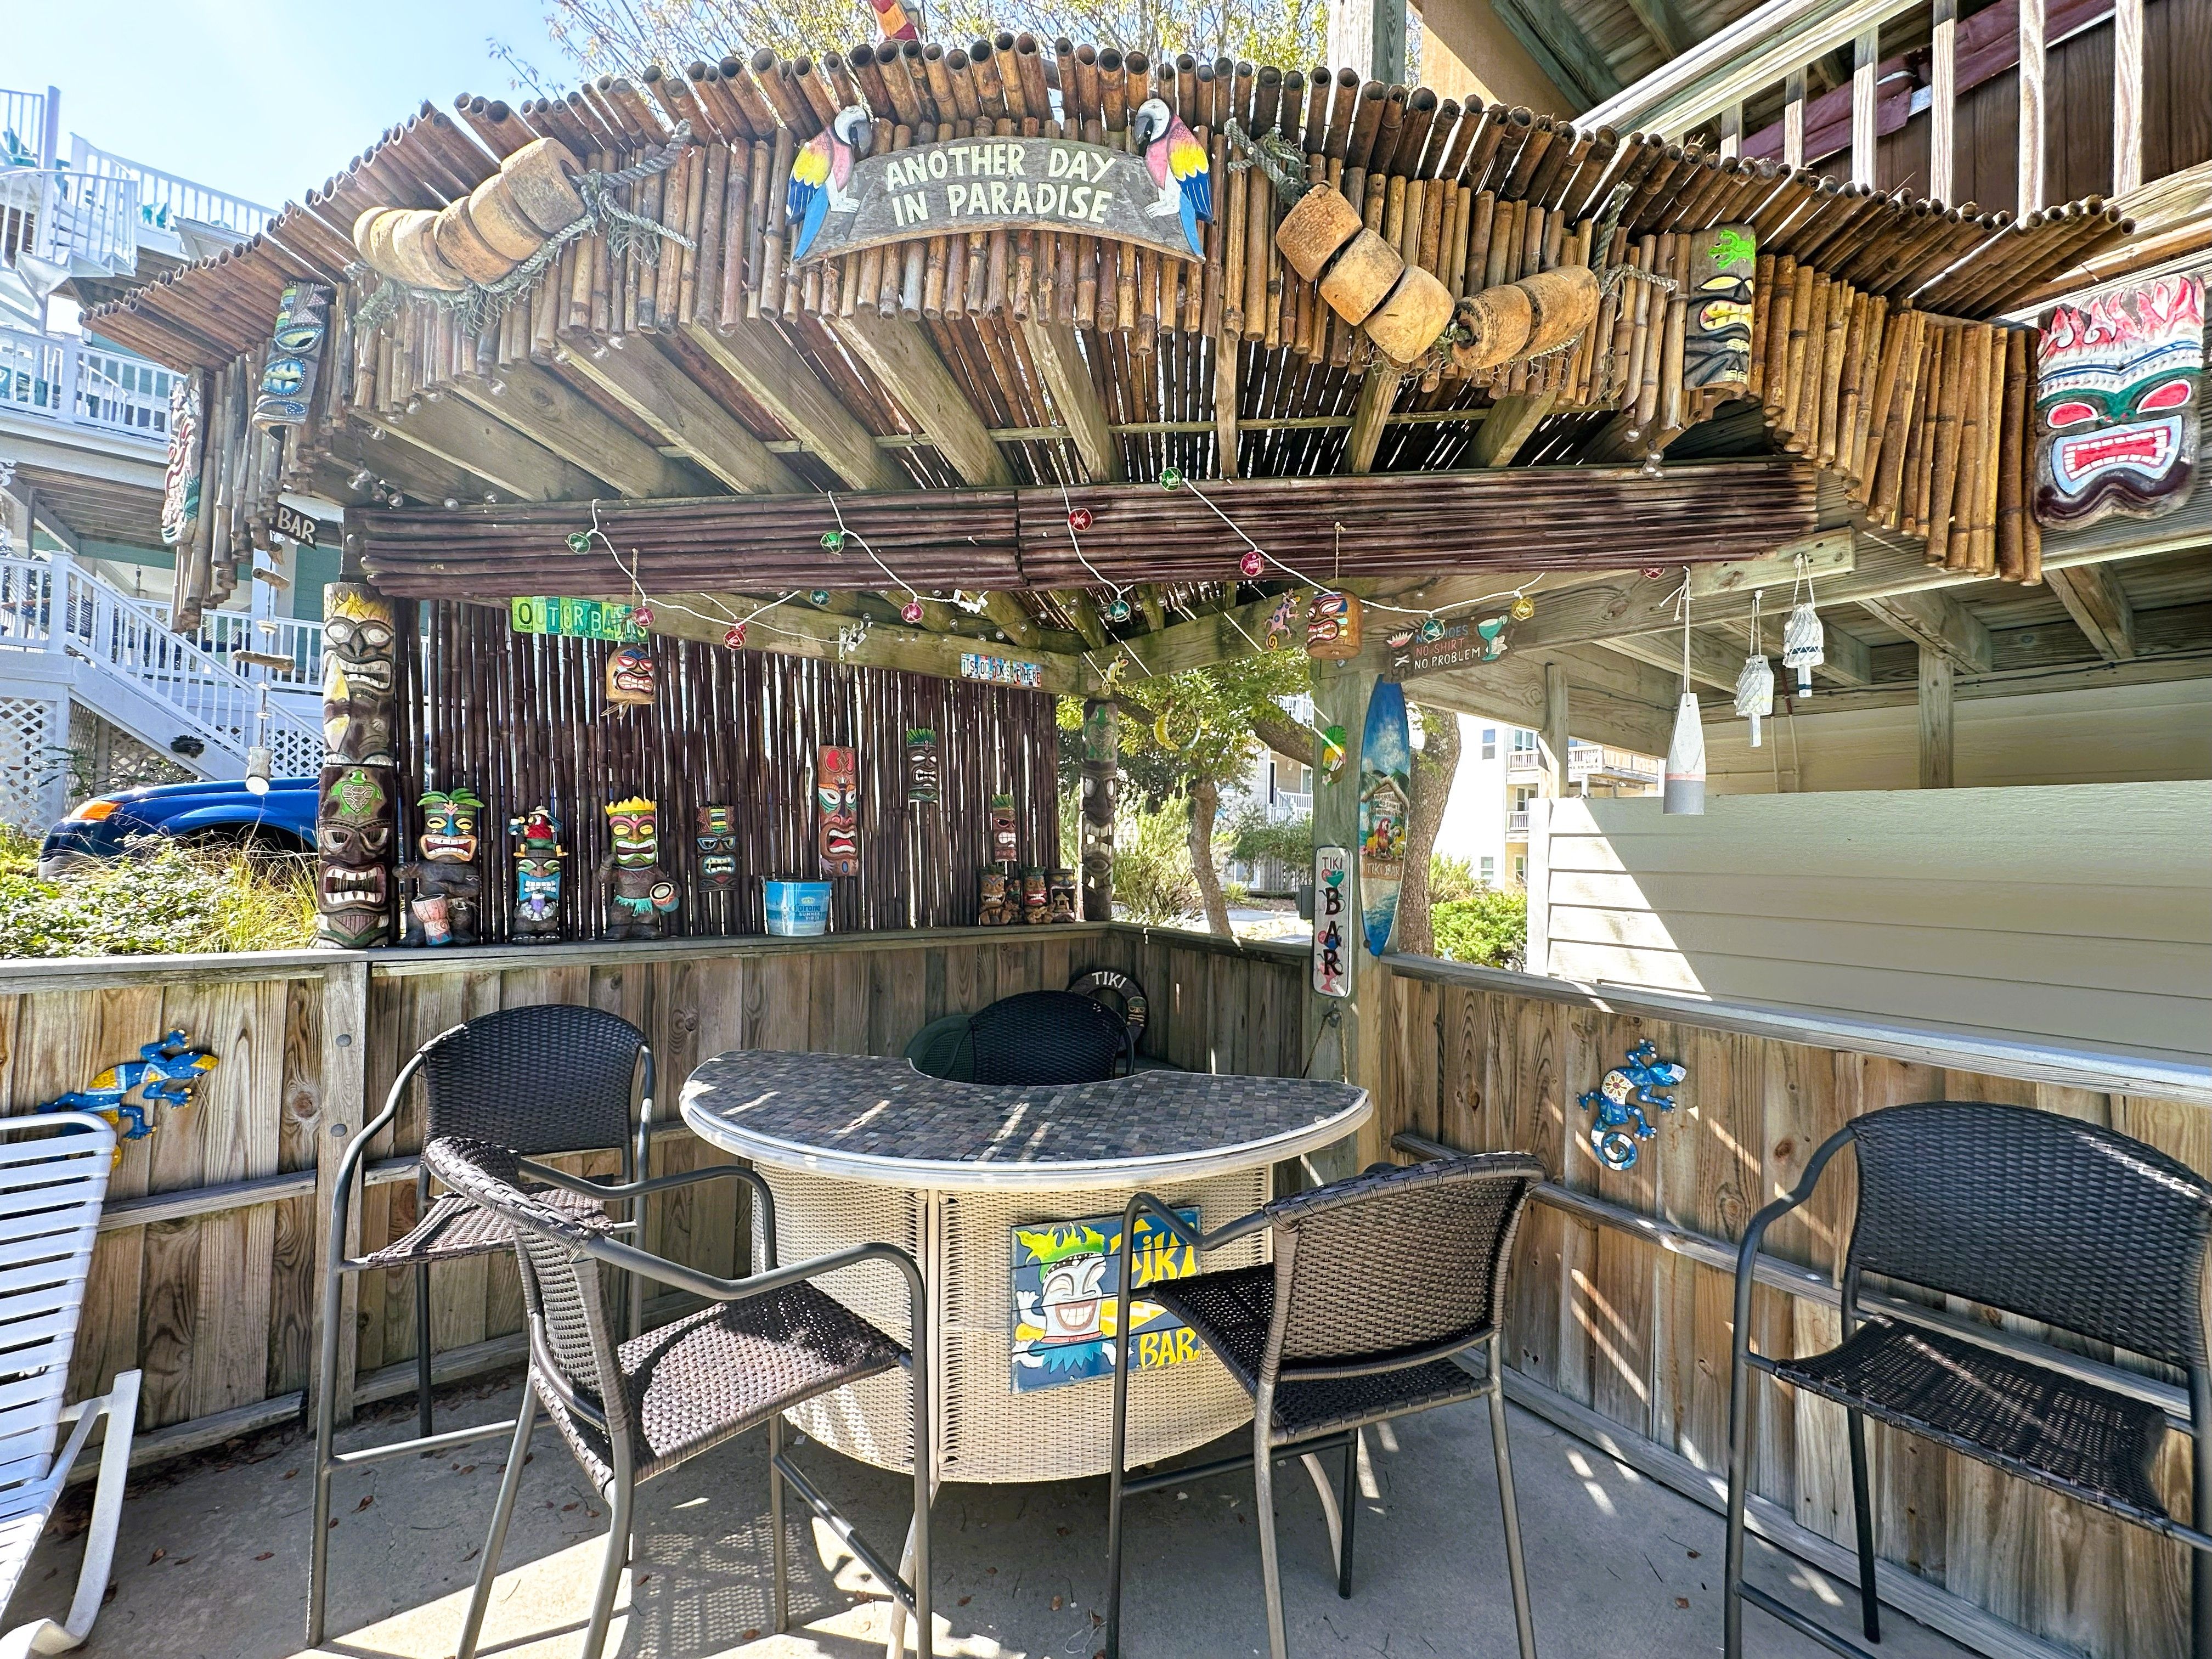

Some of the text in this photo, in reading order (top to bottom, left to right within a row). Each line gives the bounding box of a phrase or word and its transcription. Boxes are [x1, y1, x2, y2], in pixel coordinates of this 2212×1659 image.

[887, 144, 1117, 191] ANOTHER DAY
[891, 181, 1113, 227] IN PARADISE
[278, 507, 315, 544] BAR
[1414, 647, 1480, 669] NO PROBLEM
[1416, 638, 1465, 657] NO SHIRT
[1322, 857, 1342, 870] TIKI
[1367, 862, 1400, 877] TIKI BAR
[1324, 887, 1344, 976] BAR
[1092, 971, 1127, 989] TIKI
[1140, 1327, 1201, 1371] BAR
